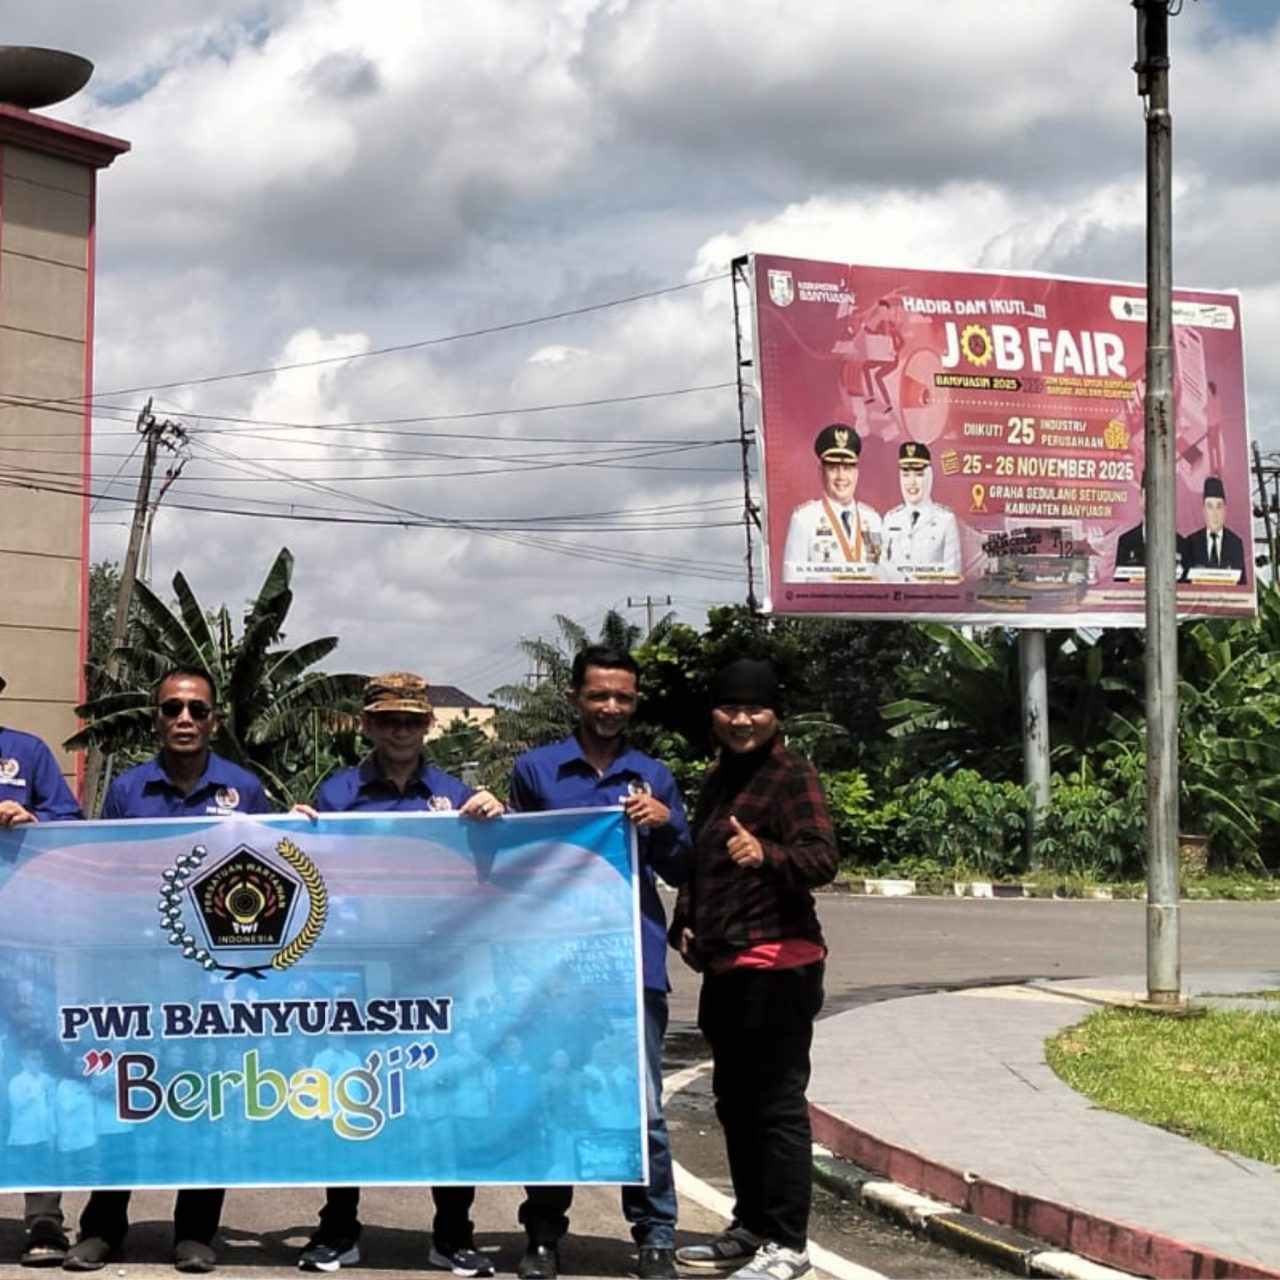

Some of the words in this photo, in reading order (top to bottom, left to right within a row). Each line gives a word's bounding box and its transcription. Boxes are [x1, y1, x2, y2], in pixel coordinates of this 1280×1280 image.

[902, 297, 952, 314] HADIR
[954, 300, 987, 315] DAN
[941, 321, 1025, 371] JOB
[1027, 326, 1127, 378] FAIR
[936, 375, 990, 388] BANYUASIN
[993, 378, 1018, 389] 2025
[1007, 417, 1036, 445] 25
[1041, 436, 1104, 448] PERUSAHAAN
[962, 454, 982, 474] 25
[995, 456, 1014, 475] 26
[1017, 457, 1096, 479] NOVEMBER
[1099, 461, 1135, 480] 2025
[989, 486, 1023, 499] GRAHA
[1005, 503, 1060, 516] KABUPATEN
[1062, 504, 1113, 517] BANYUASIN
[218, 935, 274, 944] INDONESIA
[61, 1005, 152, 1040] PWI
[163, 998, 452, 1037] BANYUASIN
